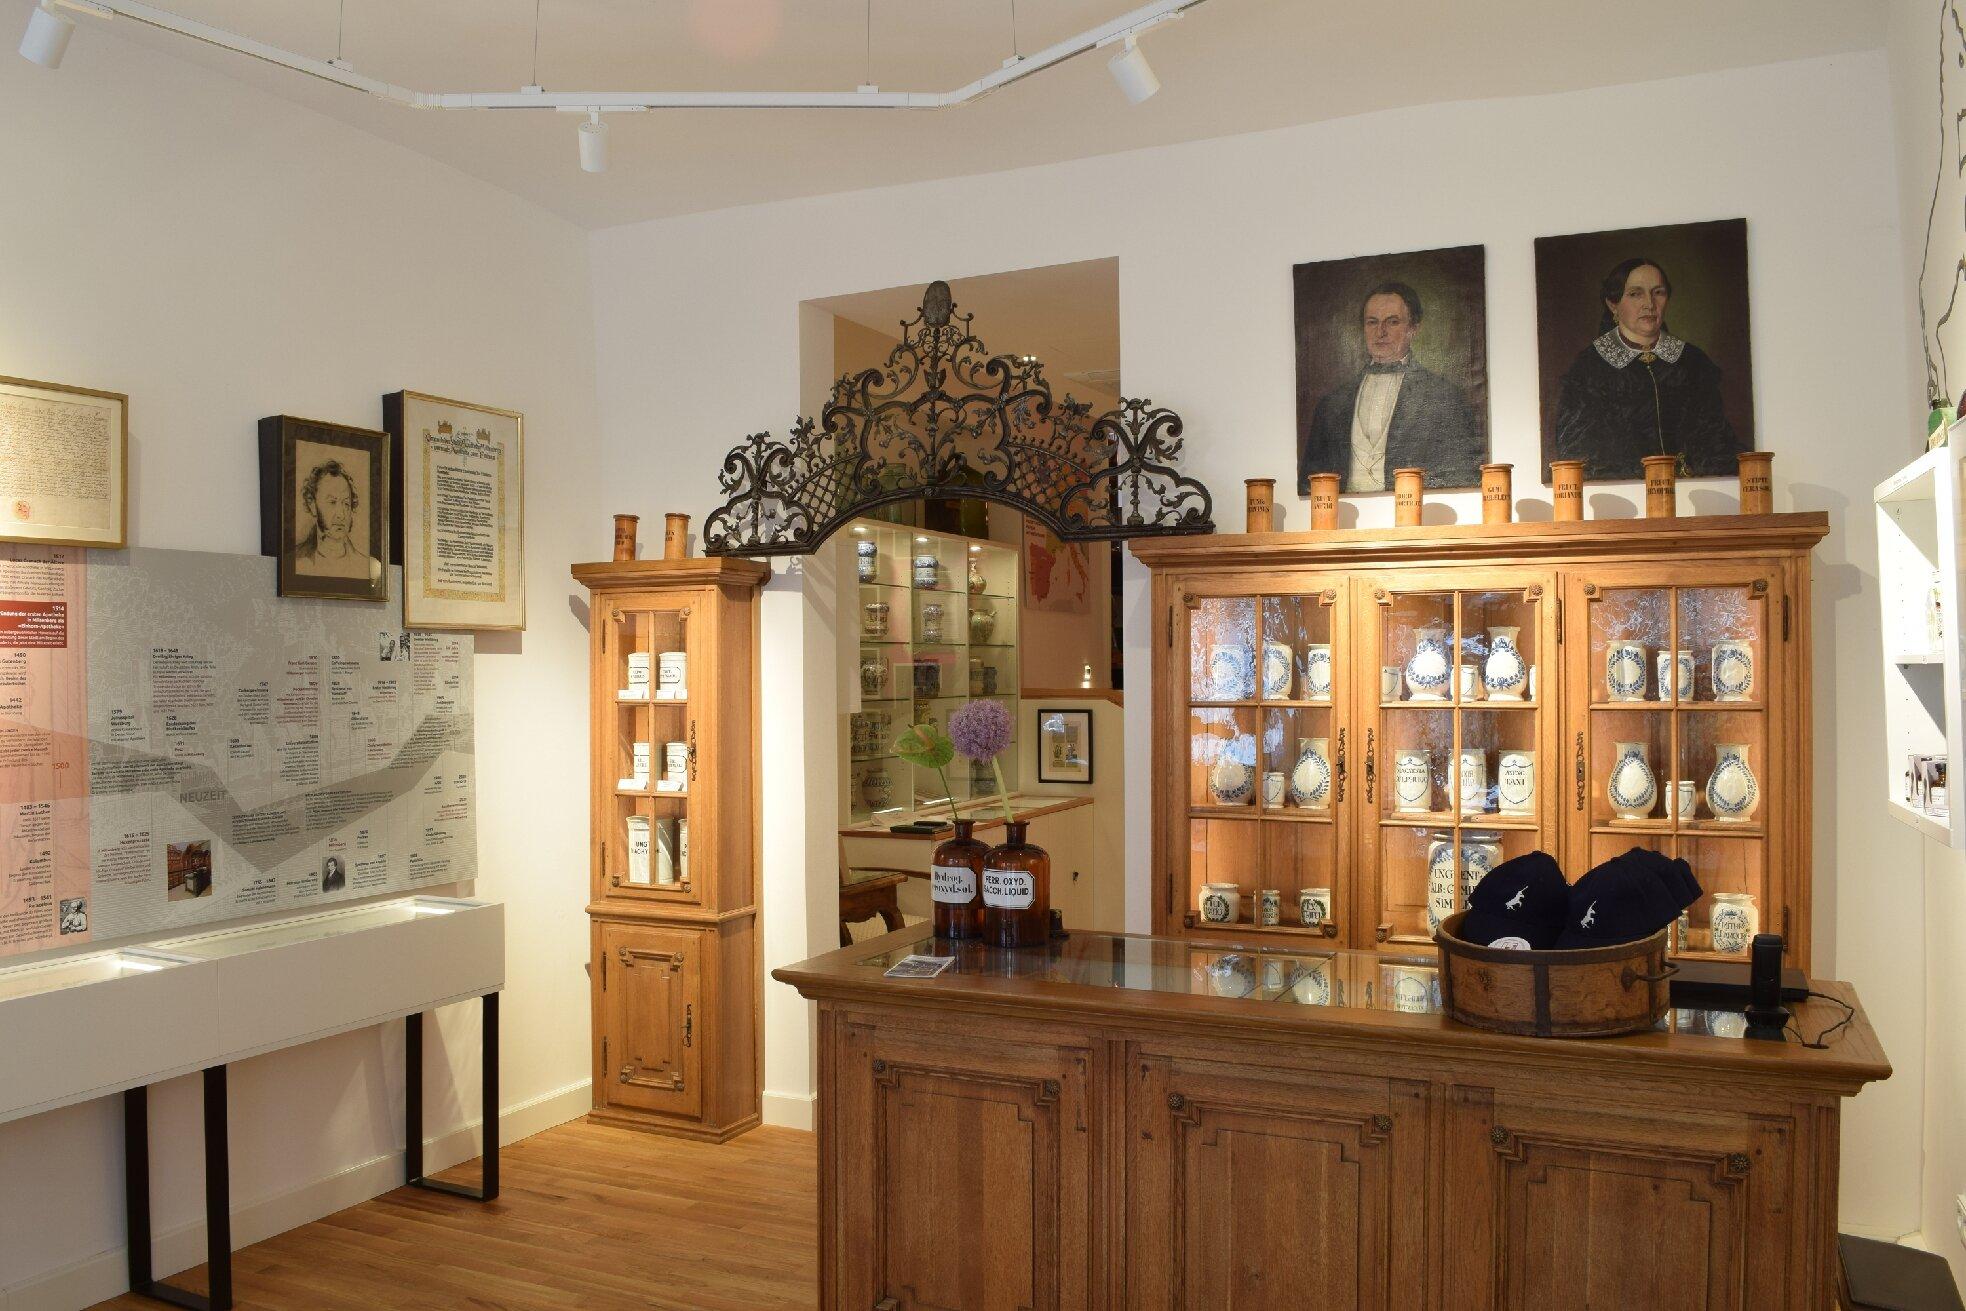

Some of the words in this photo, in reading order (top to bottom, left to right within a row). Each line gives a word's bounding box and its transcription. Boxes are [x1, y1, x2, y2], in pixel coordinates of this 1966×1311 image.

[52, 761, 69, 769] 1500
[180, 790, 226, 804] NEUZEIT
[1003, 877, 1027, 886] OXYD.
